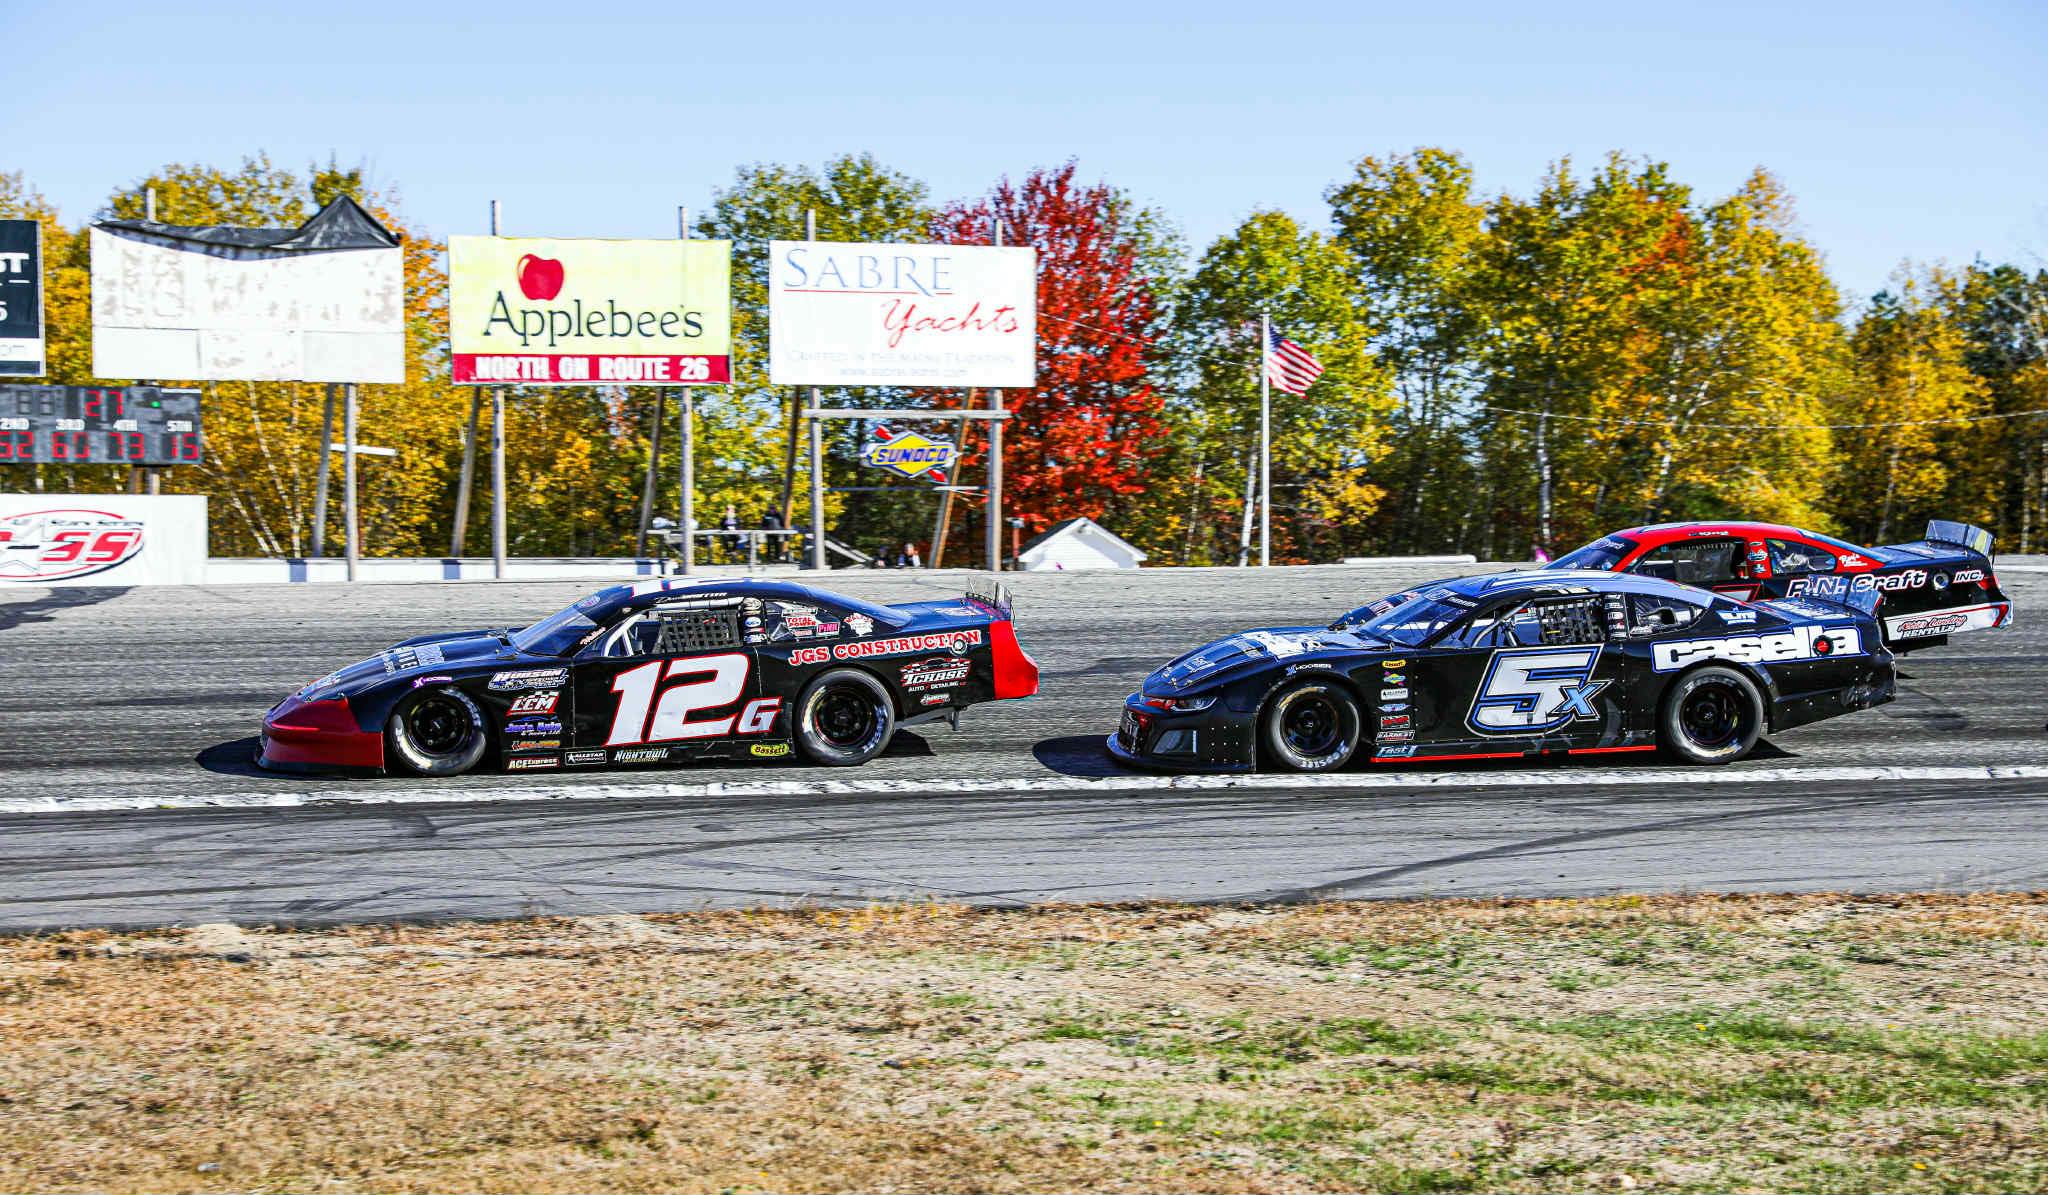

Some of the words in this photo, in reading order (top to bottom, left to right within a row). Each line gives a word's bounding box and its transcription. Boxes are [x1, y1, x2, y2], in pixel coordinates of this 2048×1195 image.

[784, 248, 952, 297] SABRE
[881, 298, 1019, 348] Yachts
[475, 356, 550, 380] NORTH
[559, 357, 590, 380] ON
[599, 358, 671, 380] ROUTE
[679, 358, 710, 380] 26
[876, 447, 949, 463] SUNOCO
[1850, 570, 1928, 593] Craft
[788, 647, 830, 666] JGS
[834, 630, 982, 662] CONSTRUCTION
[507, 759, 529, 770] ACE
